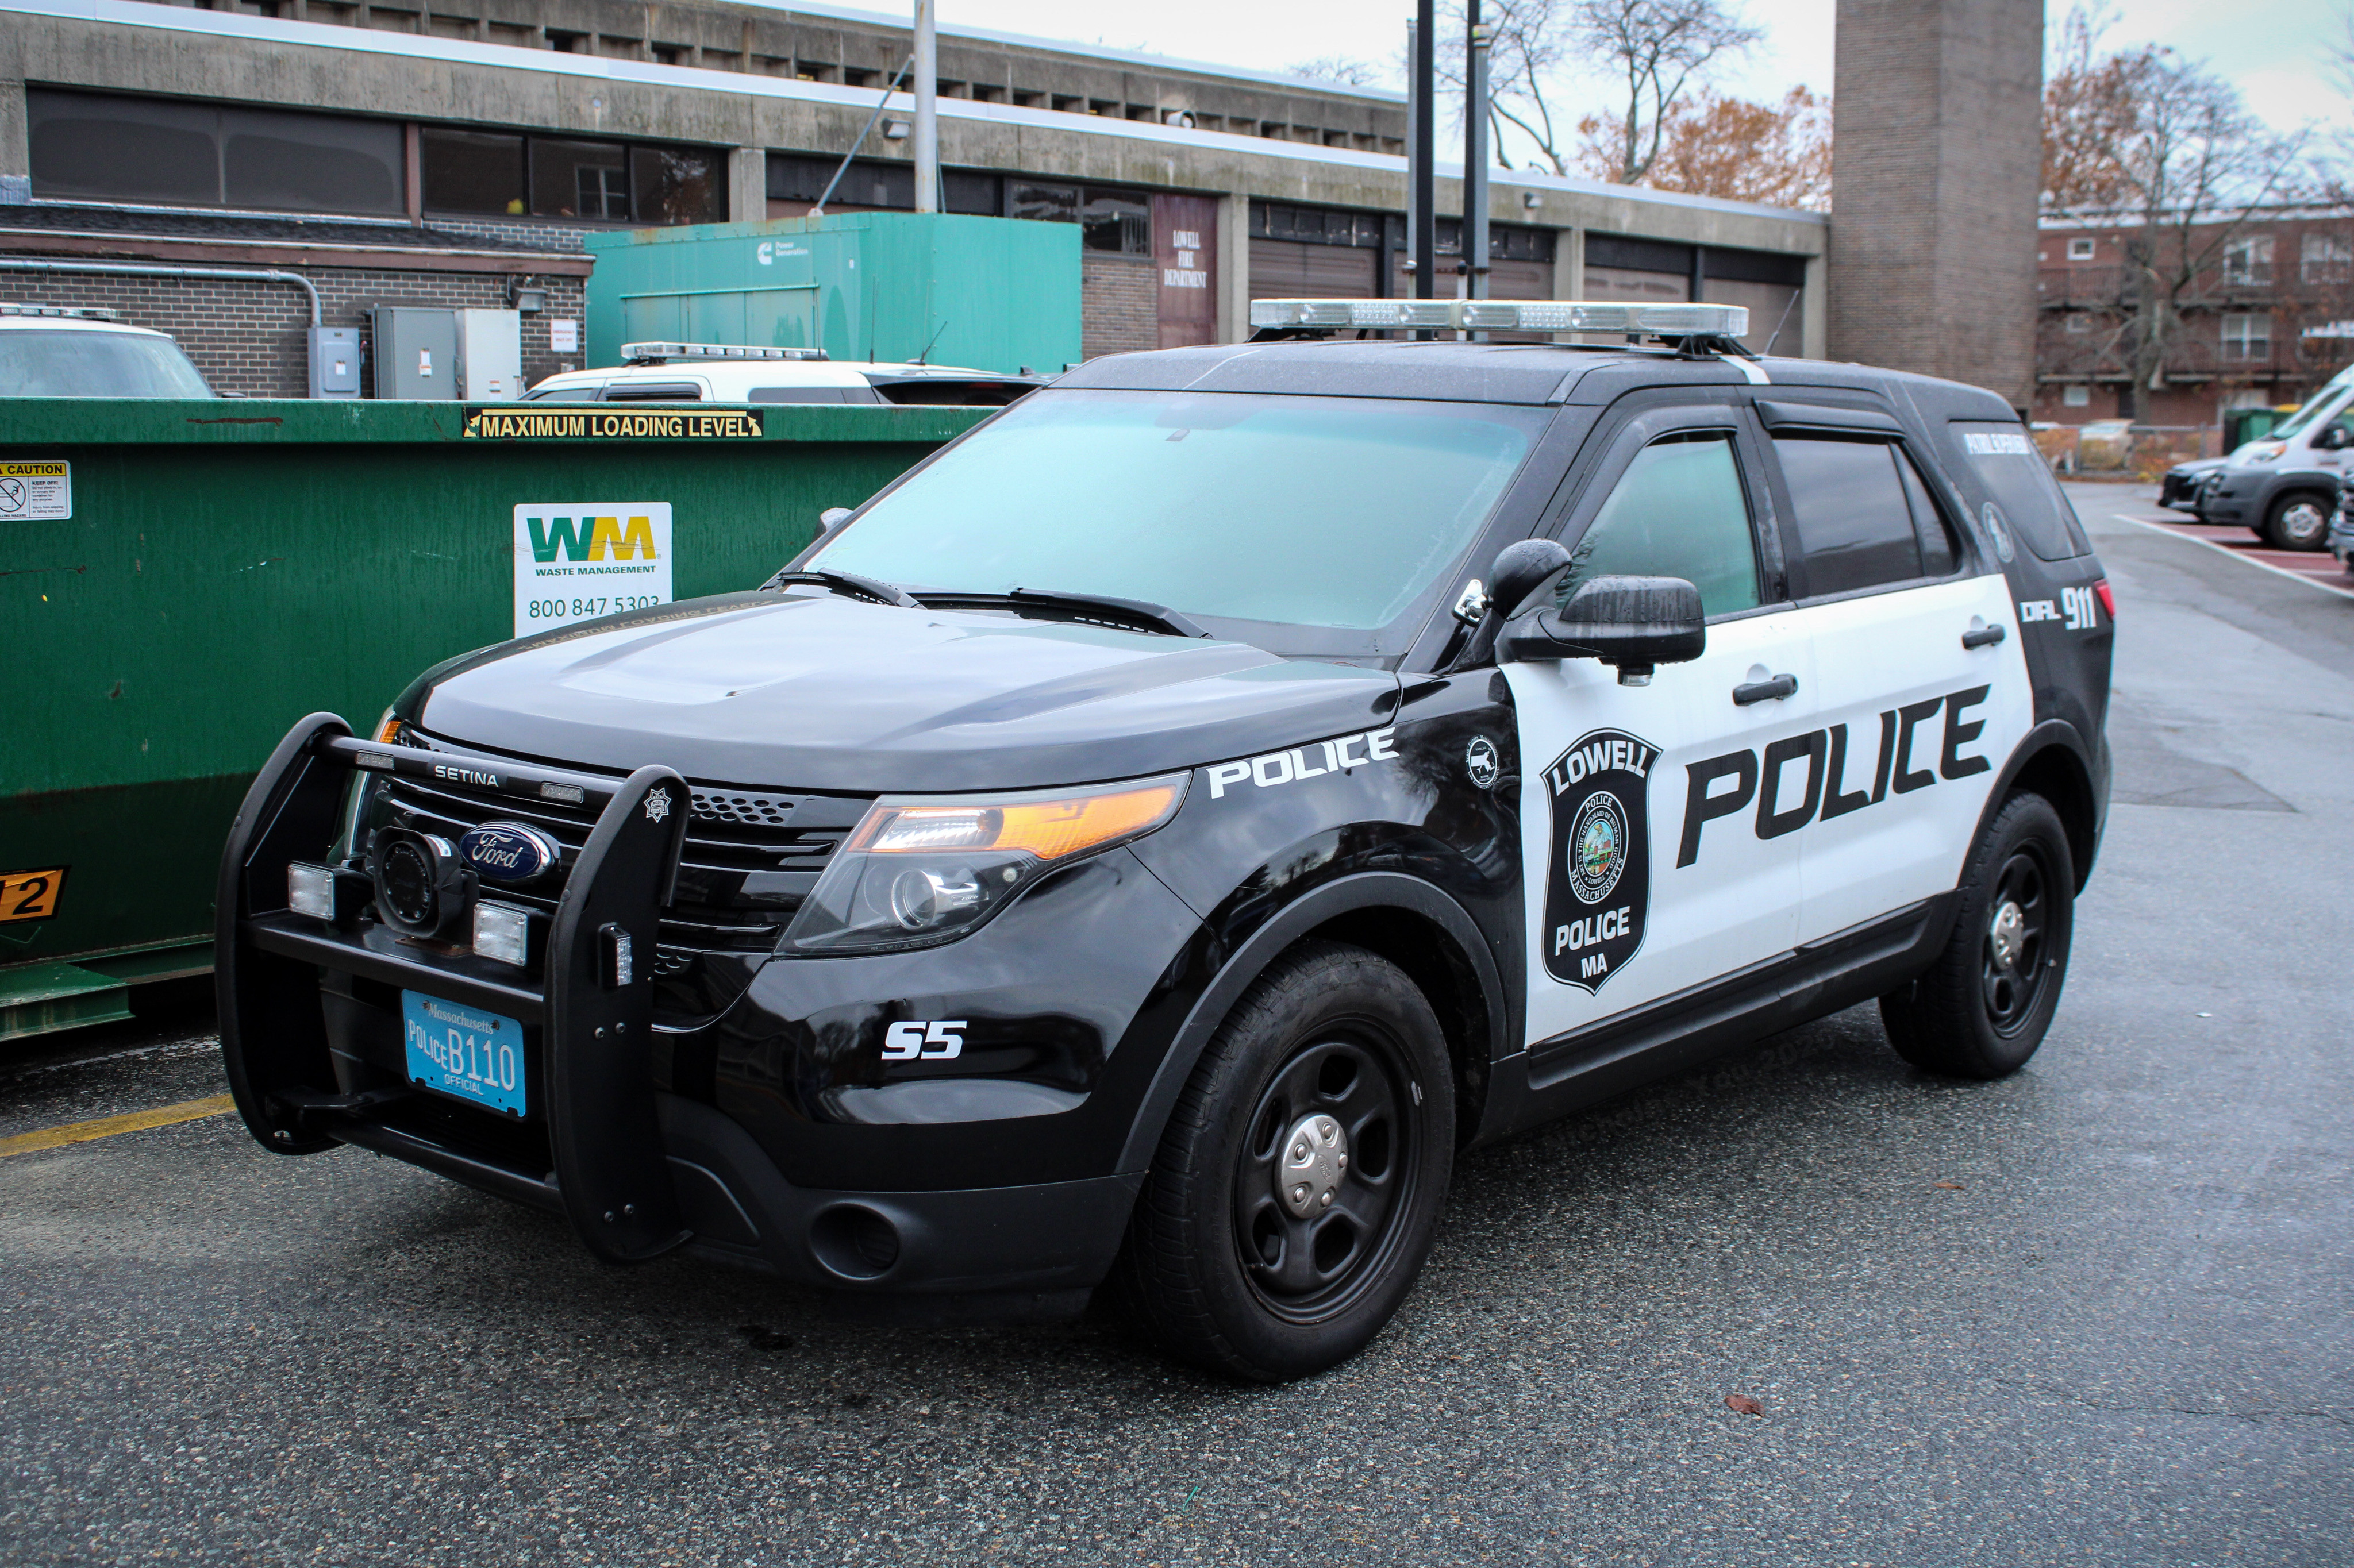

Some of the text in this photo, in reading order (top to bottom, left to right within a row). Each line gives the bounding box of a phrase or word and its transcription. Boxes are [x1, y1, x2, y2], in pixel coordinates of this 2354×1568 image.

[775, 248, 808, 256] Generation
[1173, 230, 1200, 249] LOWELL
[1178, 250, 1194, 268] FIRE
[1164, 269, 1207, 288] DEPARTMENT
[483, 416, 749, 437] MAXIMUM LOADING LEVEL
[7, 465, 63, 475] CAUTION
[526, 516, 656, 563] WM
[535, 565, 656, 577] WASTE MANAGEMENT
[529, 600, 566, 618] 800
[572, 598, 607, 616] 847
[2020, 586, 2097, 630] DIAL 911
[1206, 727, 1401, 799] POLICE
[1552, 740, 1648, 796] LOWELL
[434, 765, 499, 787] SETINA
[1676, 683, 1993, 869] POLICE
[1585, 795, 1613, 812] POLICE
[1581, 811, 1604, 836] HANDMAID
[1610, 817, 1619, 844] HUMAN
[472, 833, 523, 868] Ford
[1610, 847, 1618, 869] GOOD
[1571, 858, 1623, 900] MASSACHUSETTS
[1588, 875, 1605, 884] LOWELL
[1555, 906, 1630, 956] POLICE
[1581, 953, 1608, 978] MA
[429, 1003, 494, 1034] Massachusetts
[881, 1021, 967, 1060] S5
[408, 1019, 515, 1091] POLICE B110
[444, 1074, 484, 1096] OFFICIAL
